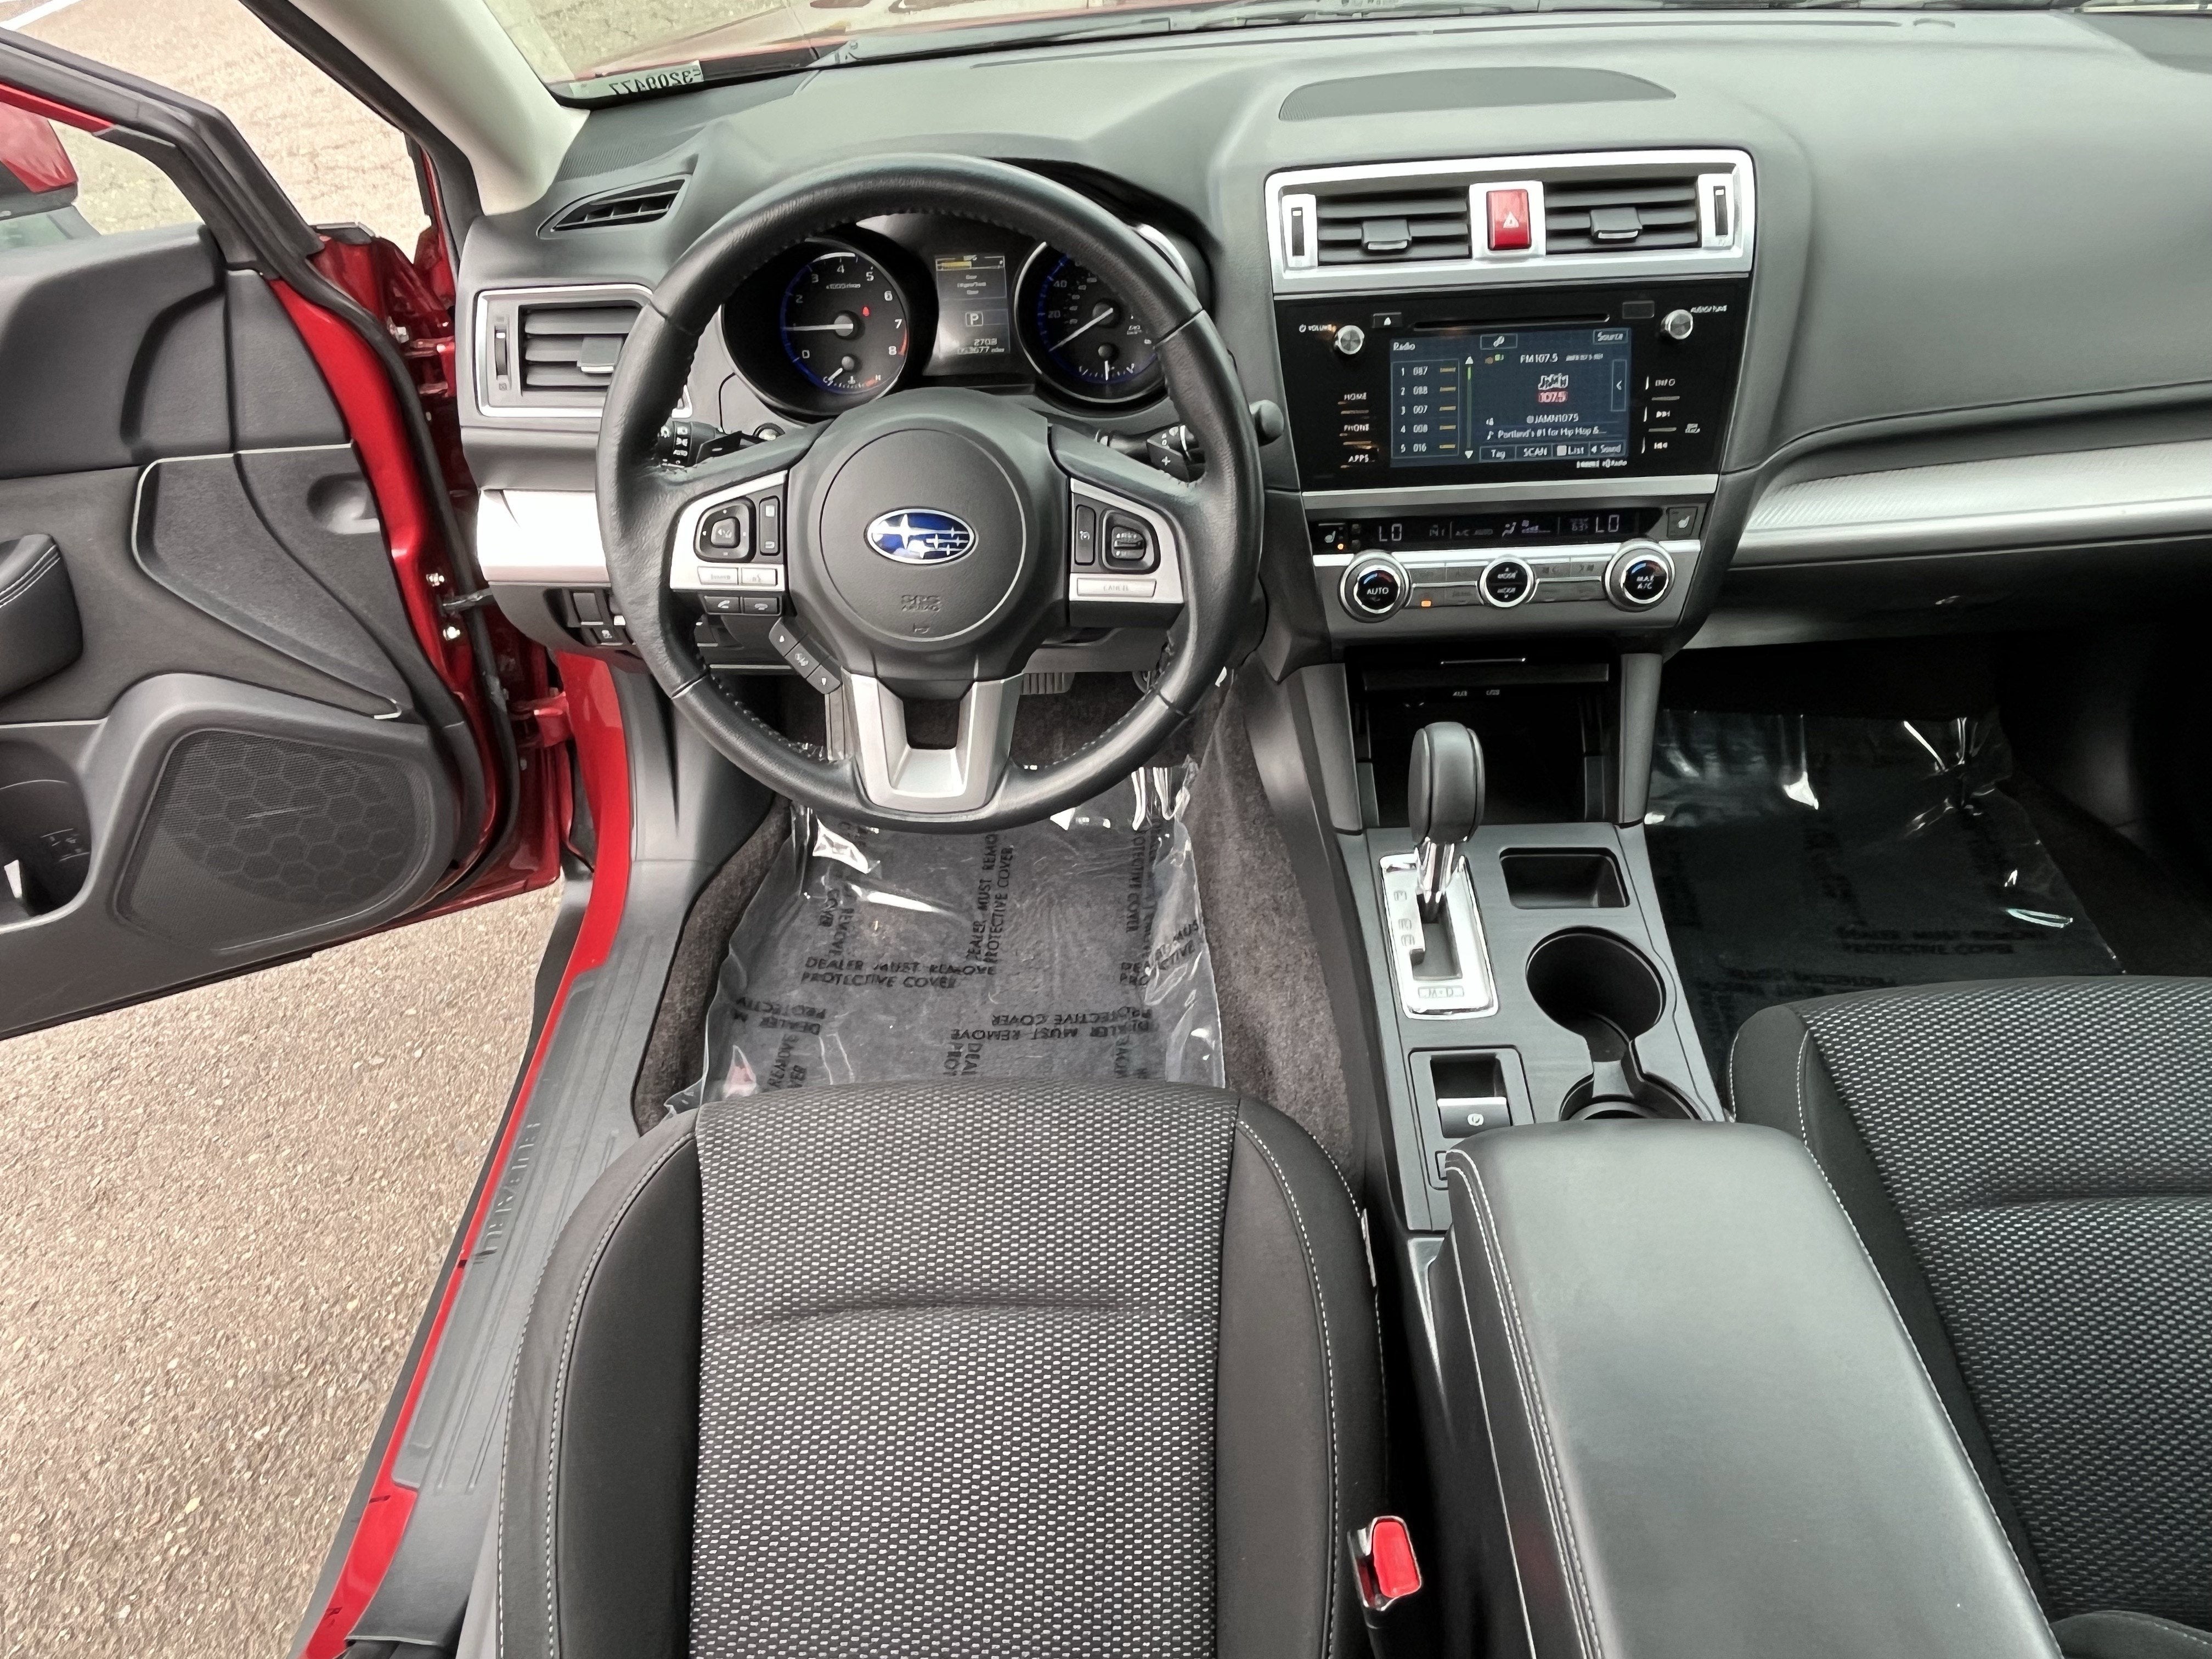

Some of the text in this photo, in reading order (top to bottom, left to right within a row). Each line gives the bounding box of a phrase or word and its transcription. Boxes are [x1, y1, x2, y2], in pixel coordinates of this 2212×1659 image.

[866, 271, 874, 281] 5
[895, 319, 902, 329] 7
[970, 313, 979, 325] P
[1367, 586, 1389, 595] AUTO
[991, 1013, 1045, 1026] COVER
[950, 1028, 1020, 1041] REMOVE
